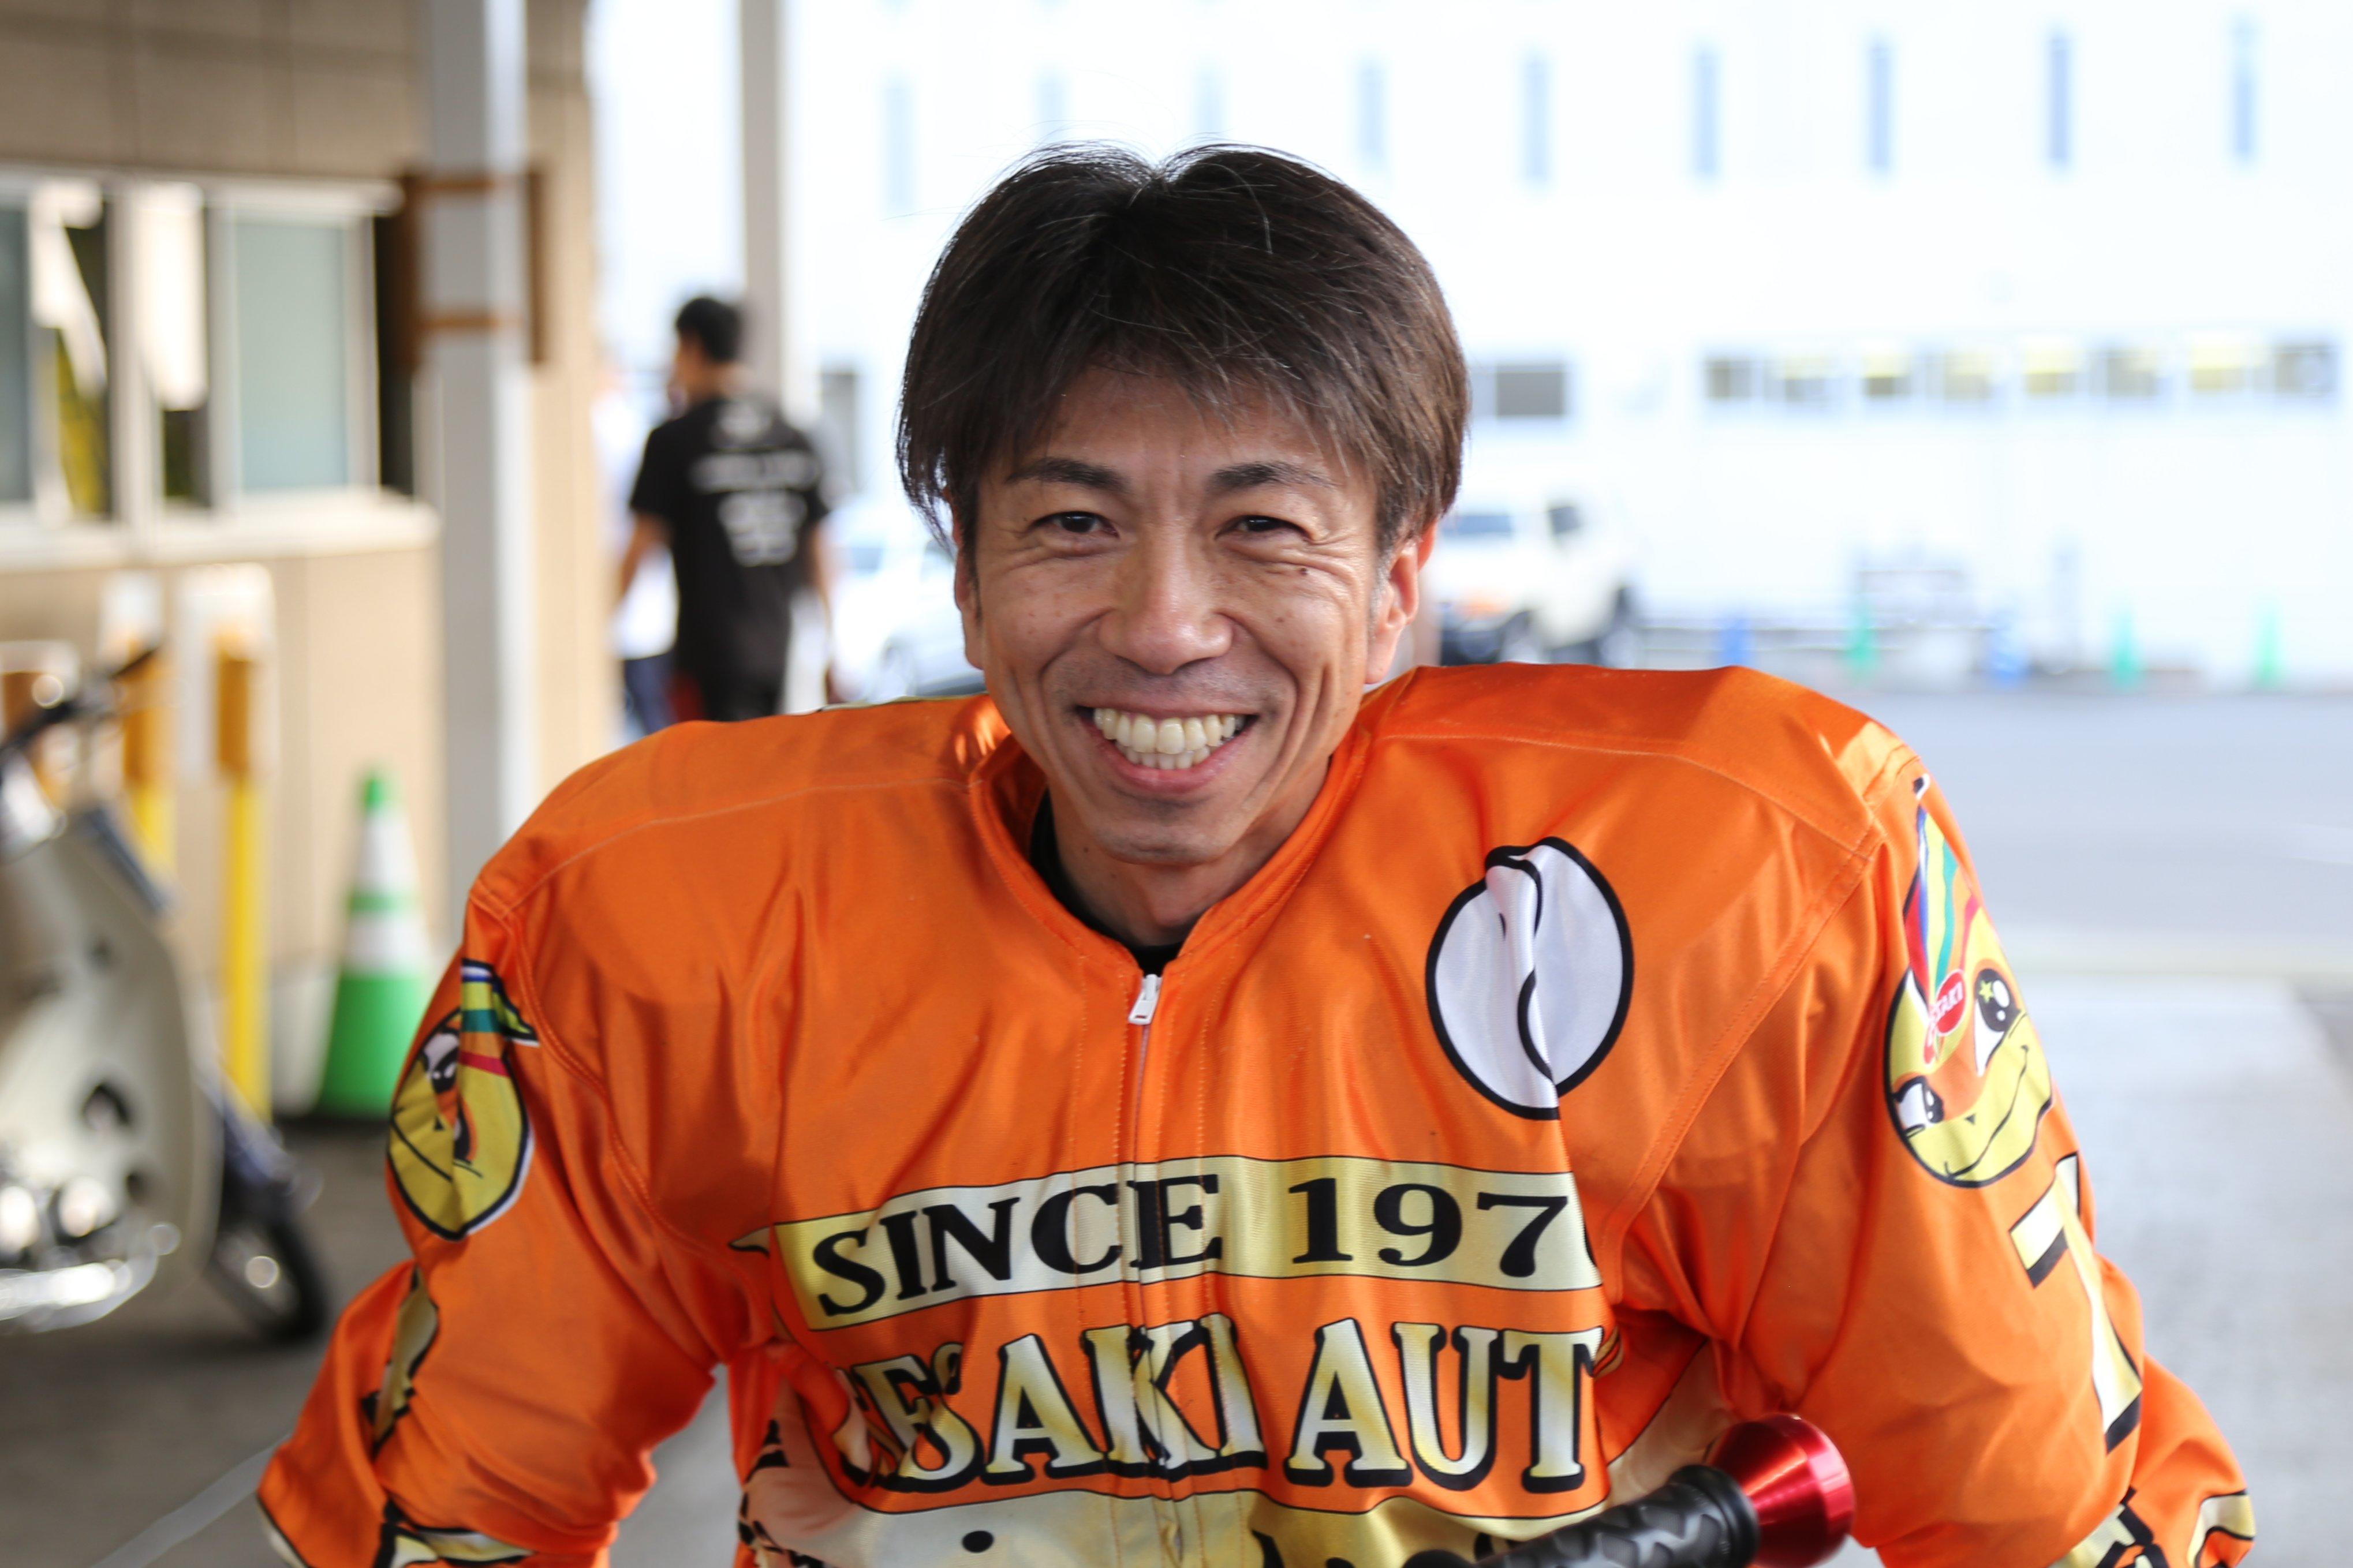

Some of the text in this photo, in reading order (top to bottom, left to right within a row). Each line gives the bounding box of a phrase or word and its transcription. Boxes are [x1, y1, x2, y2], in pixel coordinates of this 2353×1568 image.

[813, 1173, 1597, 1316] SINCE 197
[1283, 1316, 1623, 1495] AUT
